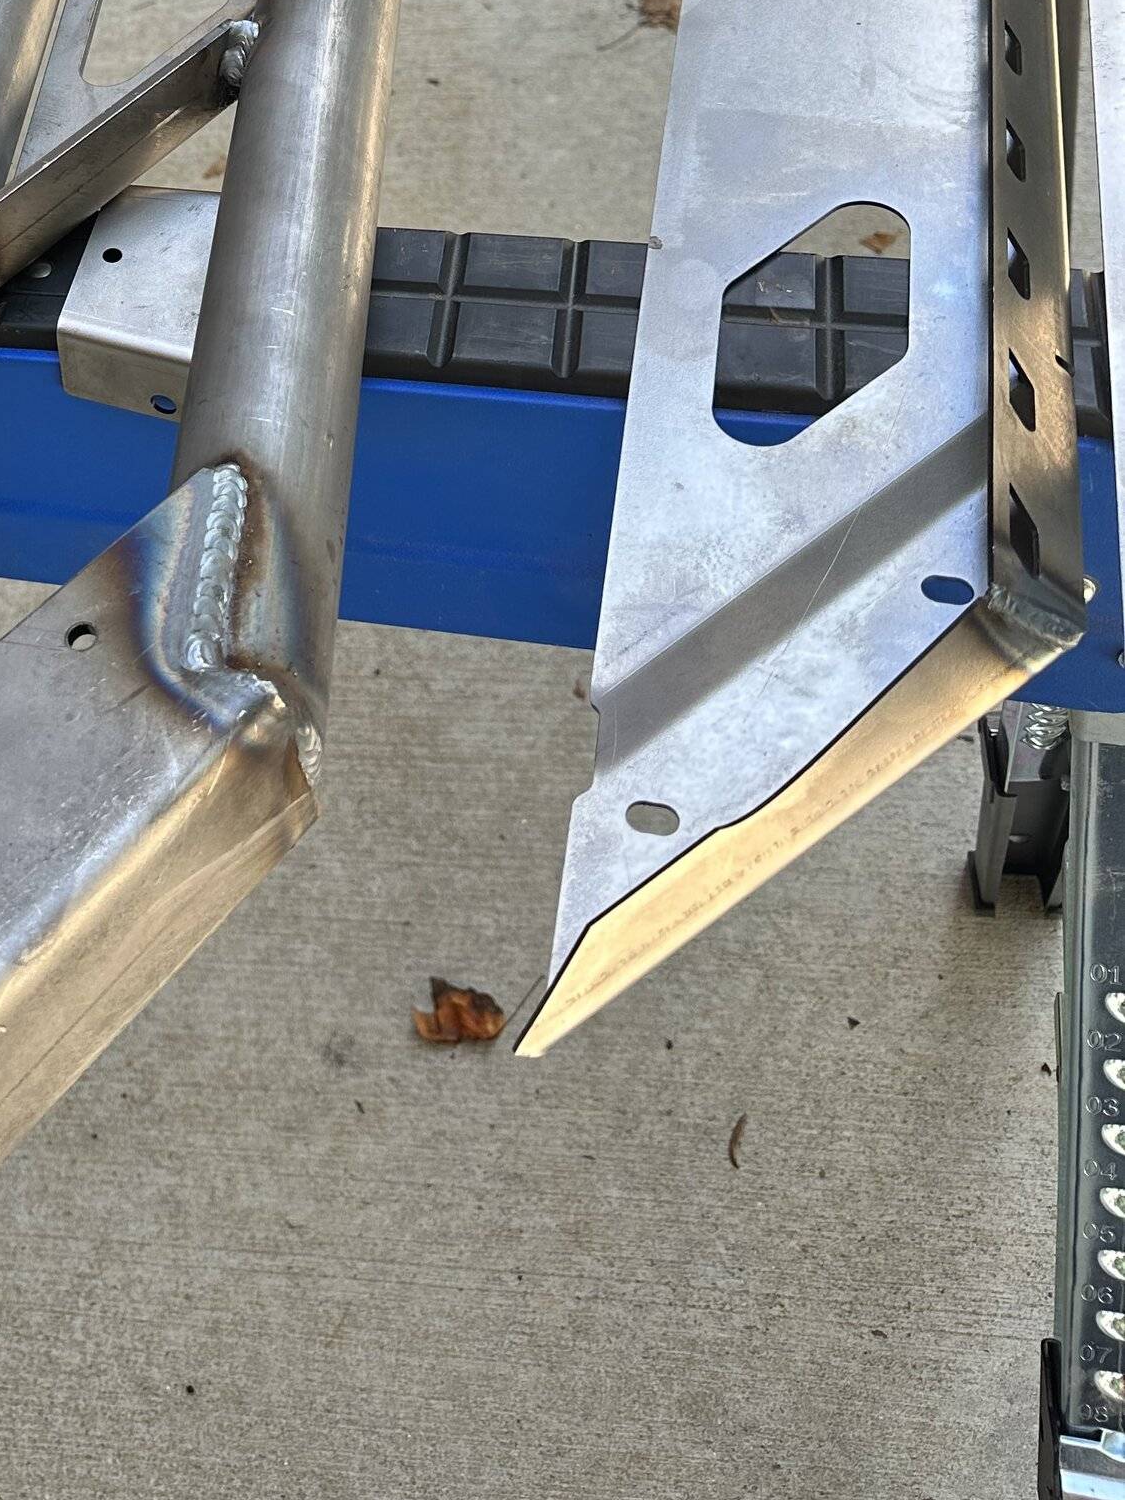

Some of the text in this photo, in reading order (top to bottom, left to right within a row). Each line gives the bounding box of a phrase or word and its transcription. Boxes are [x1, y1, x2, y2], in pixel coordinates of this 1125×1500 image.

[1089, 963, 1123, 986] 01
[1086, 1029, 1123, 1051] 02
[1084, 1095, 1120, 1117] 03
[1083, 1158, 1117, 1181] 04
[1082, 1221, 1115, 1243] 05
[1080, 1284, 1114, 1305] 06
[1078, 1343, 1113, 1364] 07
